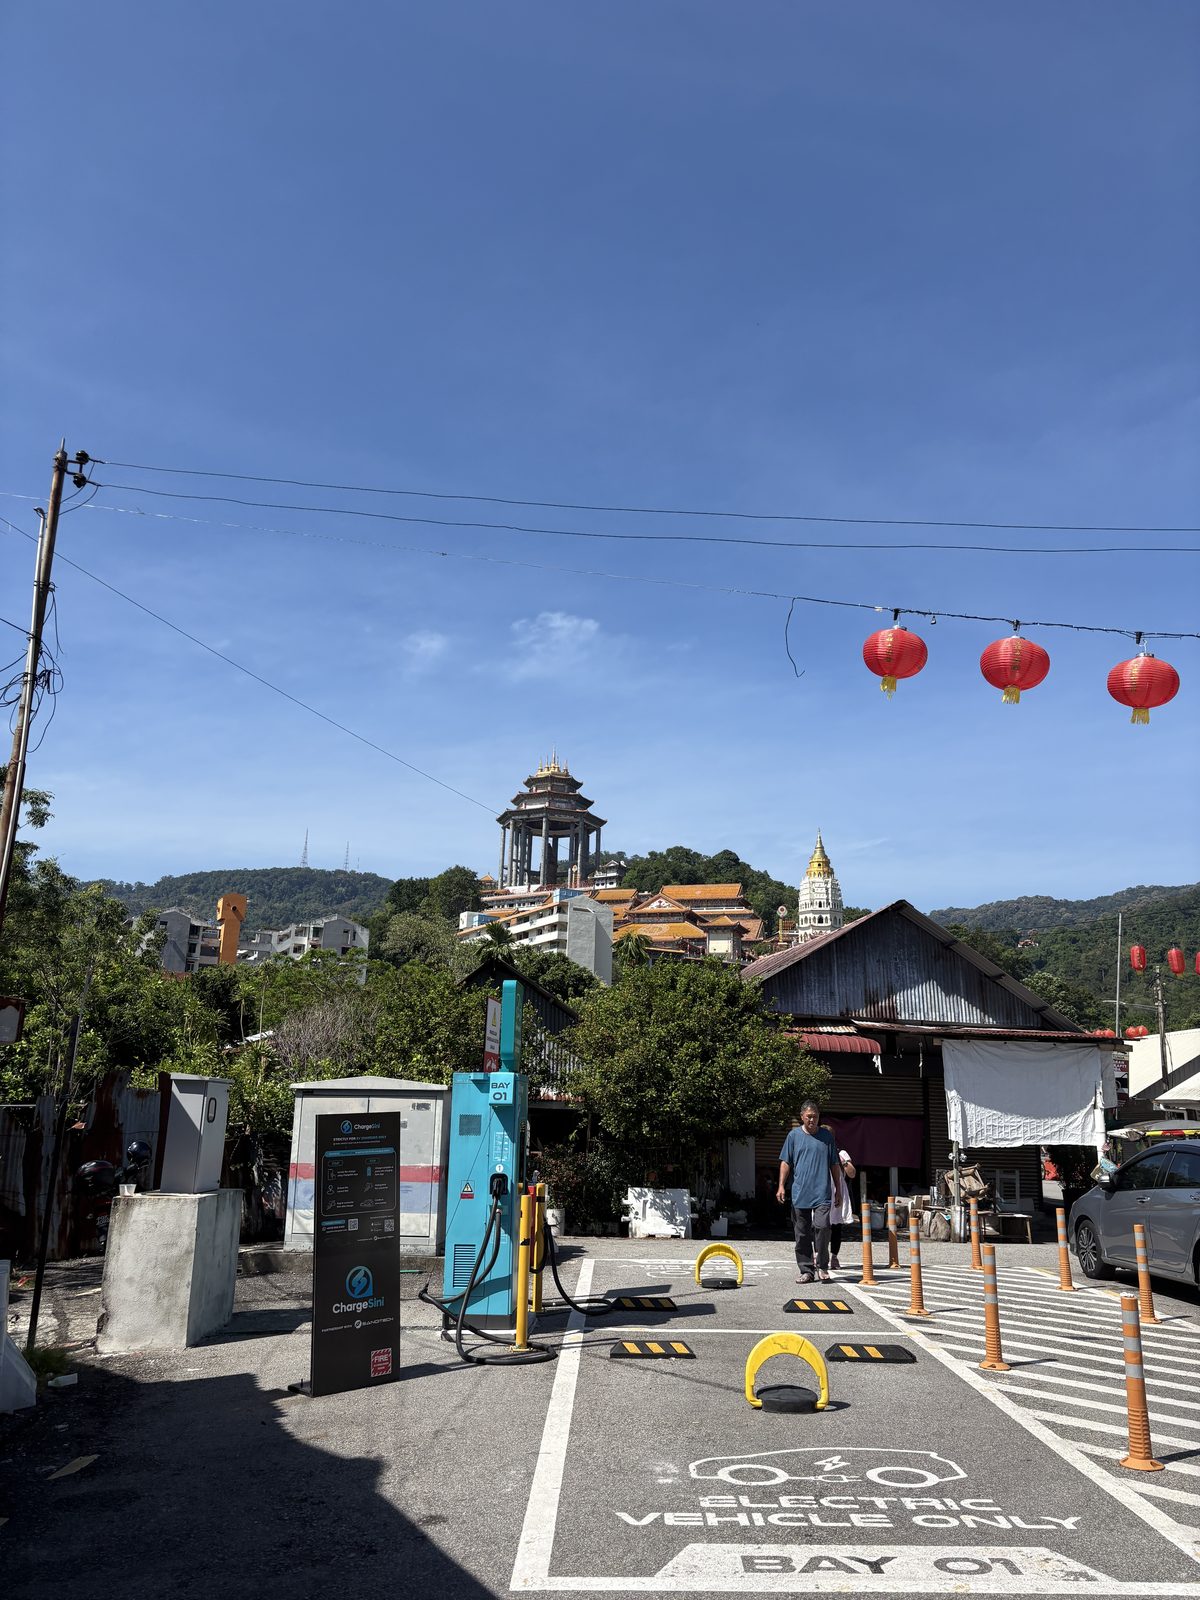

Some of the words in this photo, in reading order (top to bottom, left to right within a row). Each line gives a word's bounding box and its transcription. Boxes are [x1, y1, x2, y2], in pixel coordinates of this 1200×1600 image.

[492, 1092, 507, 1101] 01
[332, 1297, 385, 1313] ChargeSini
[374, 1355, 389, 1363] FIRE
[700, 1496, 1002, 1511] ELECTRIC
[615, 1512, 894, 1528] VEHICLE
[912, 1515, 1082, 1530] ONLY
[741, 1555, 898, 1575] BAY
[933, 1557, 1024, 1576] 01
